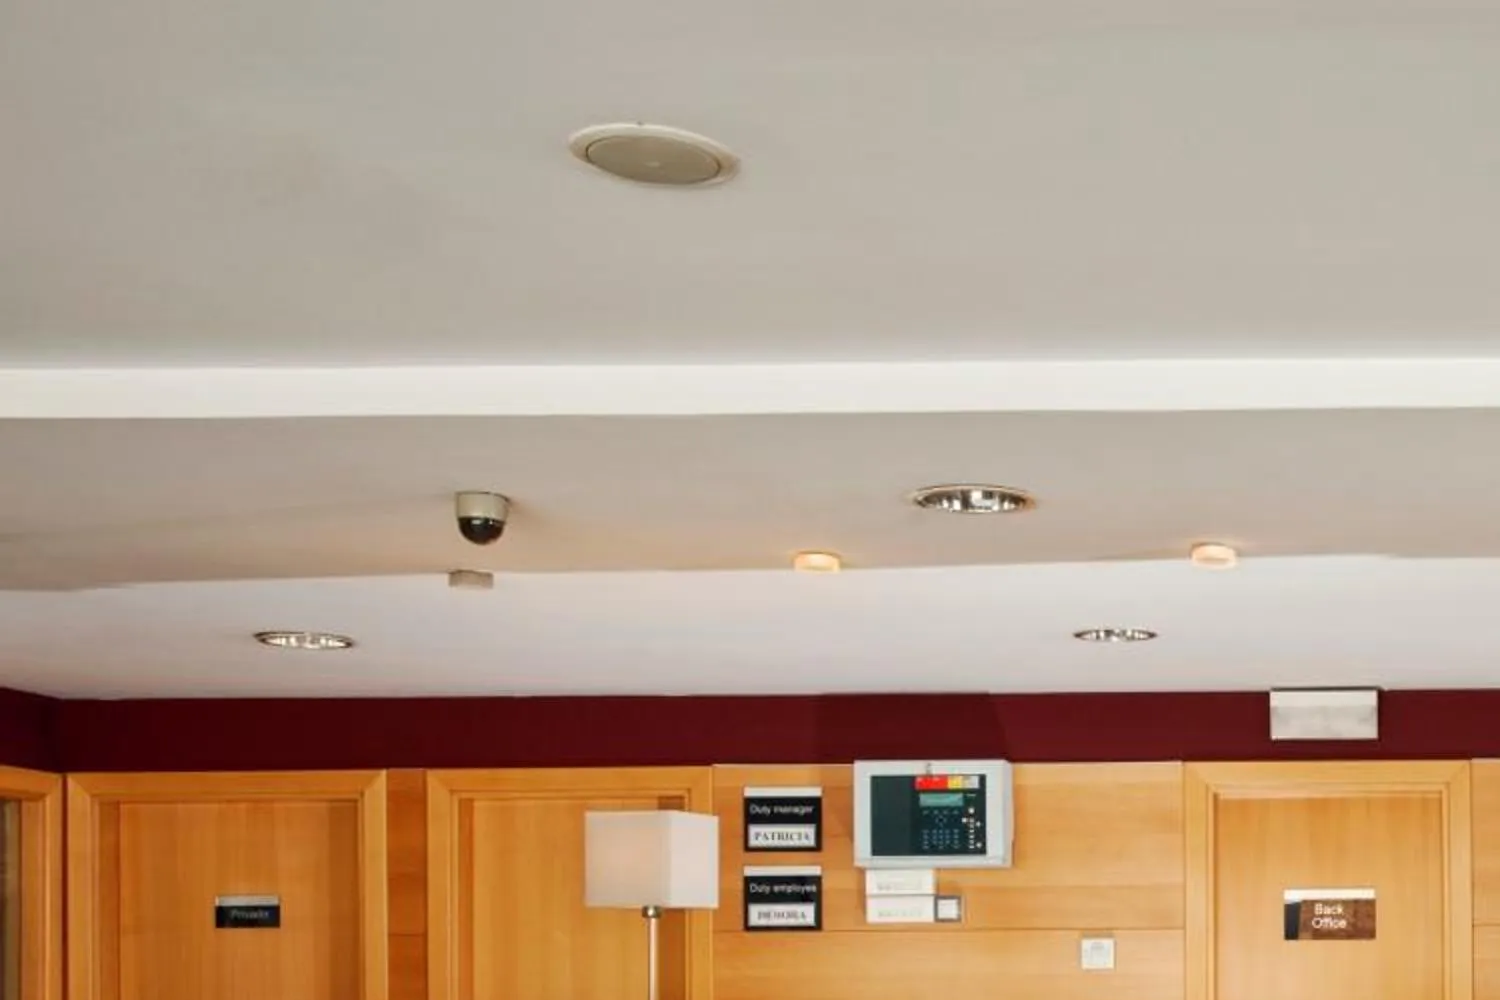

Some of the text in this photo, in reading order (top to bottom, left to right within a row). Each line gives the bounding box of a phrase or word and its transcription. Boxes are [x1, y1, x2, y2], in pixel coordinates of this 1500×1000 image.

[750, 804, 813, 816] Duty manager
[754, 831, 811, 841] PATRICIA
[749, 883, 817, 895] Duty employee
[1314, 903, 1345, 916] Back
[1311, 917, 1347, 929] Office
